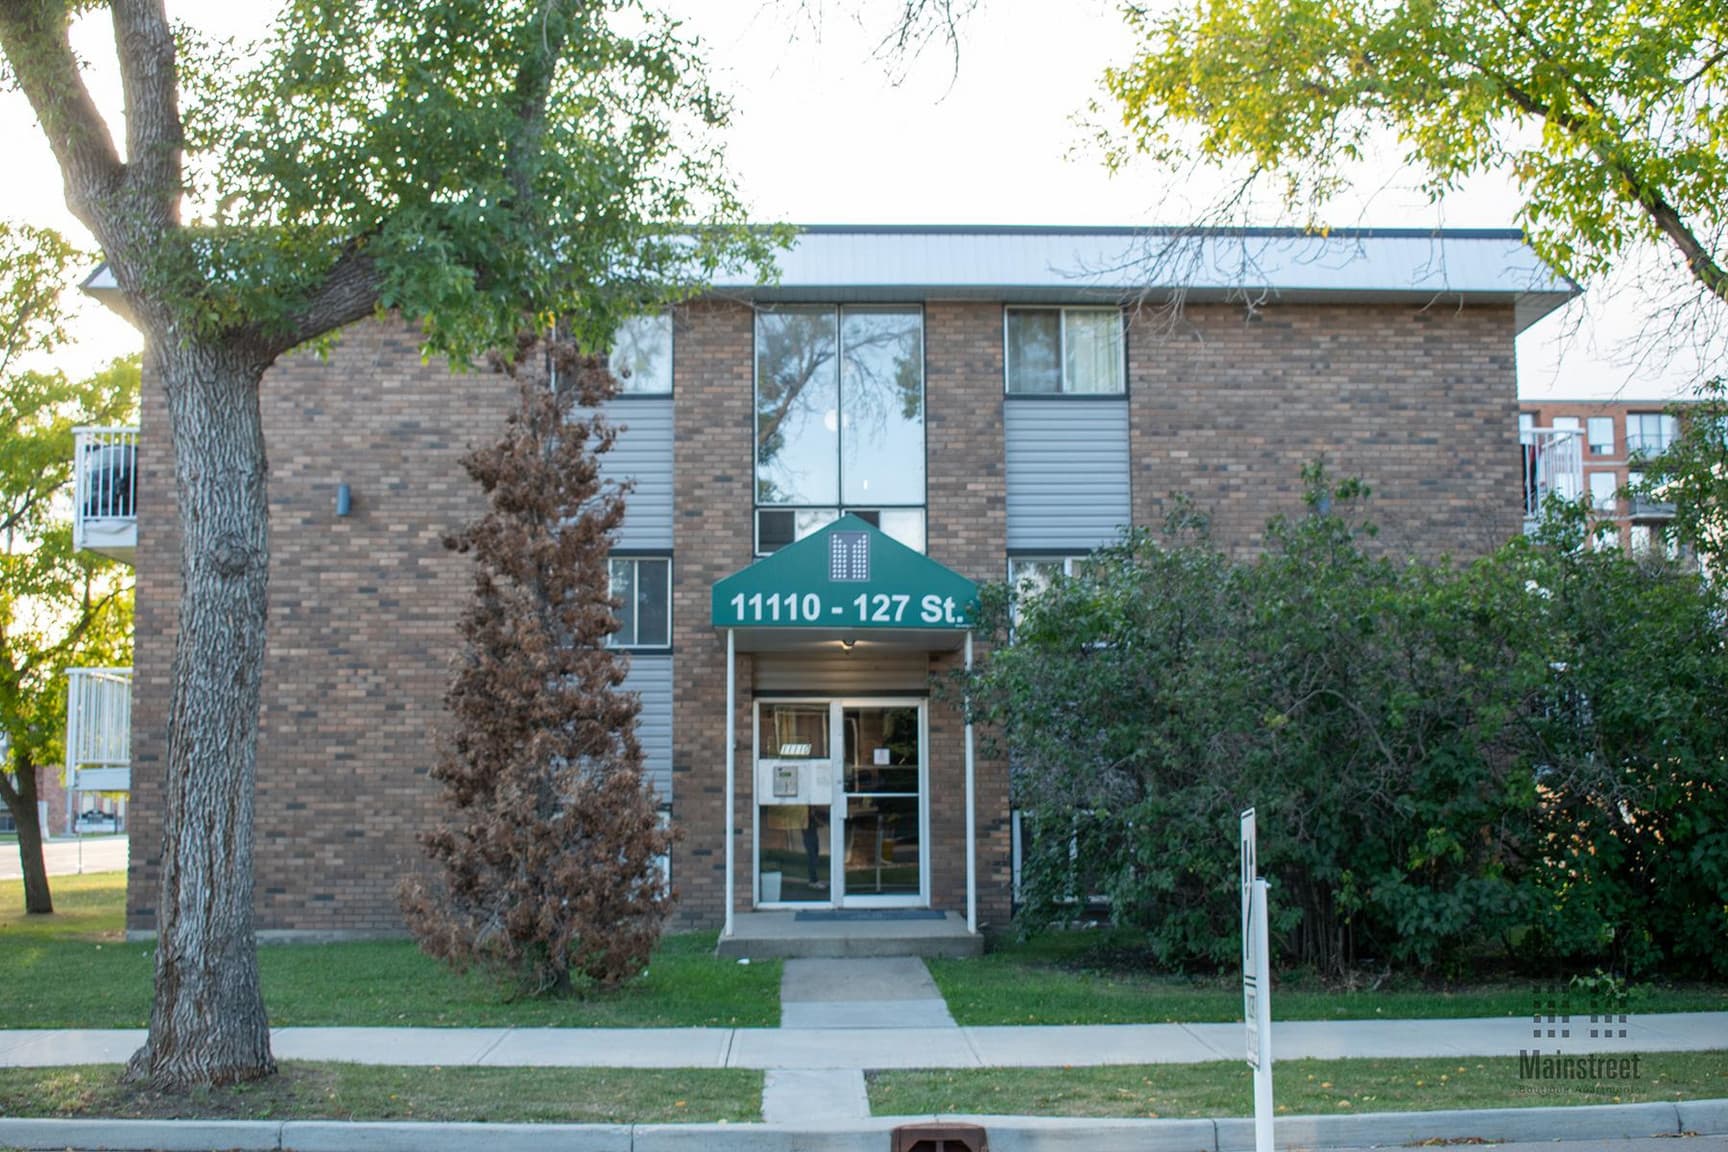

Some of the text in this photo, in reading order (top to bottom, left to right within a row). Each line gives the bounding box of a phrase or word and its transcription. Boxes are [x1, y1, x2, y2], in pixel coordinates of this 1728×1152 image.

[731, 593, 820, 621] 11110
[853, 593, 910, 622] 127
[921, 594, 963, 623] St.
